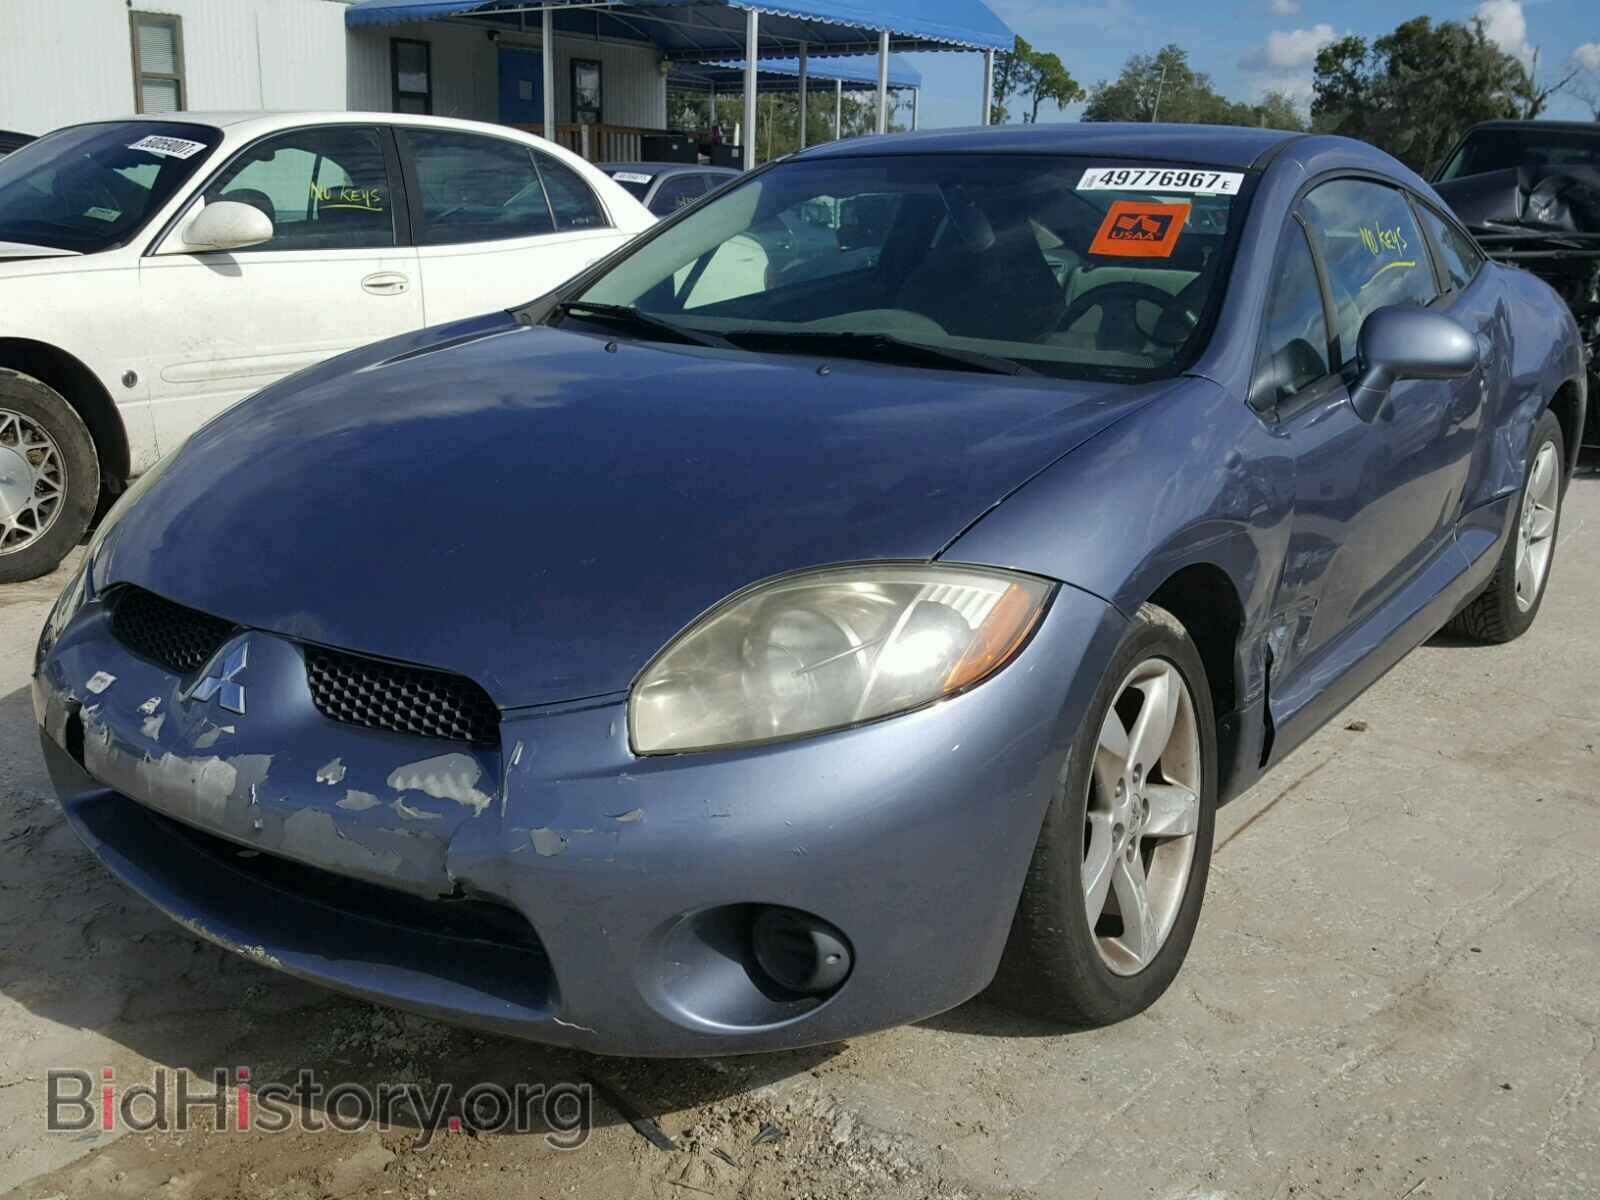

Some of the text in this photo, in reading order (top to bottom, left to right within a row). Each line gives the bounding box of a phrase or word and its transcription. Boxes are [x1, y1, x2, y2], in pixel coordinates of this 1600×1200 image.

[1100, 170, 1221, 189] 49776967
[1221, 180, 1231, 190] E
[1111, 231, 1155, 241] USAA
